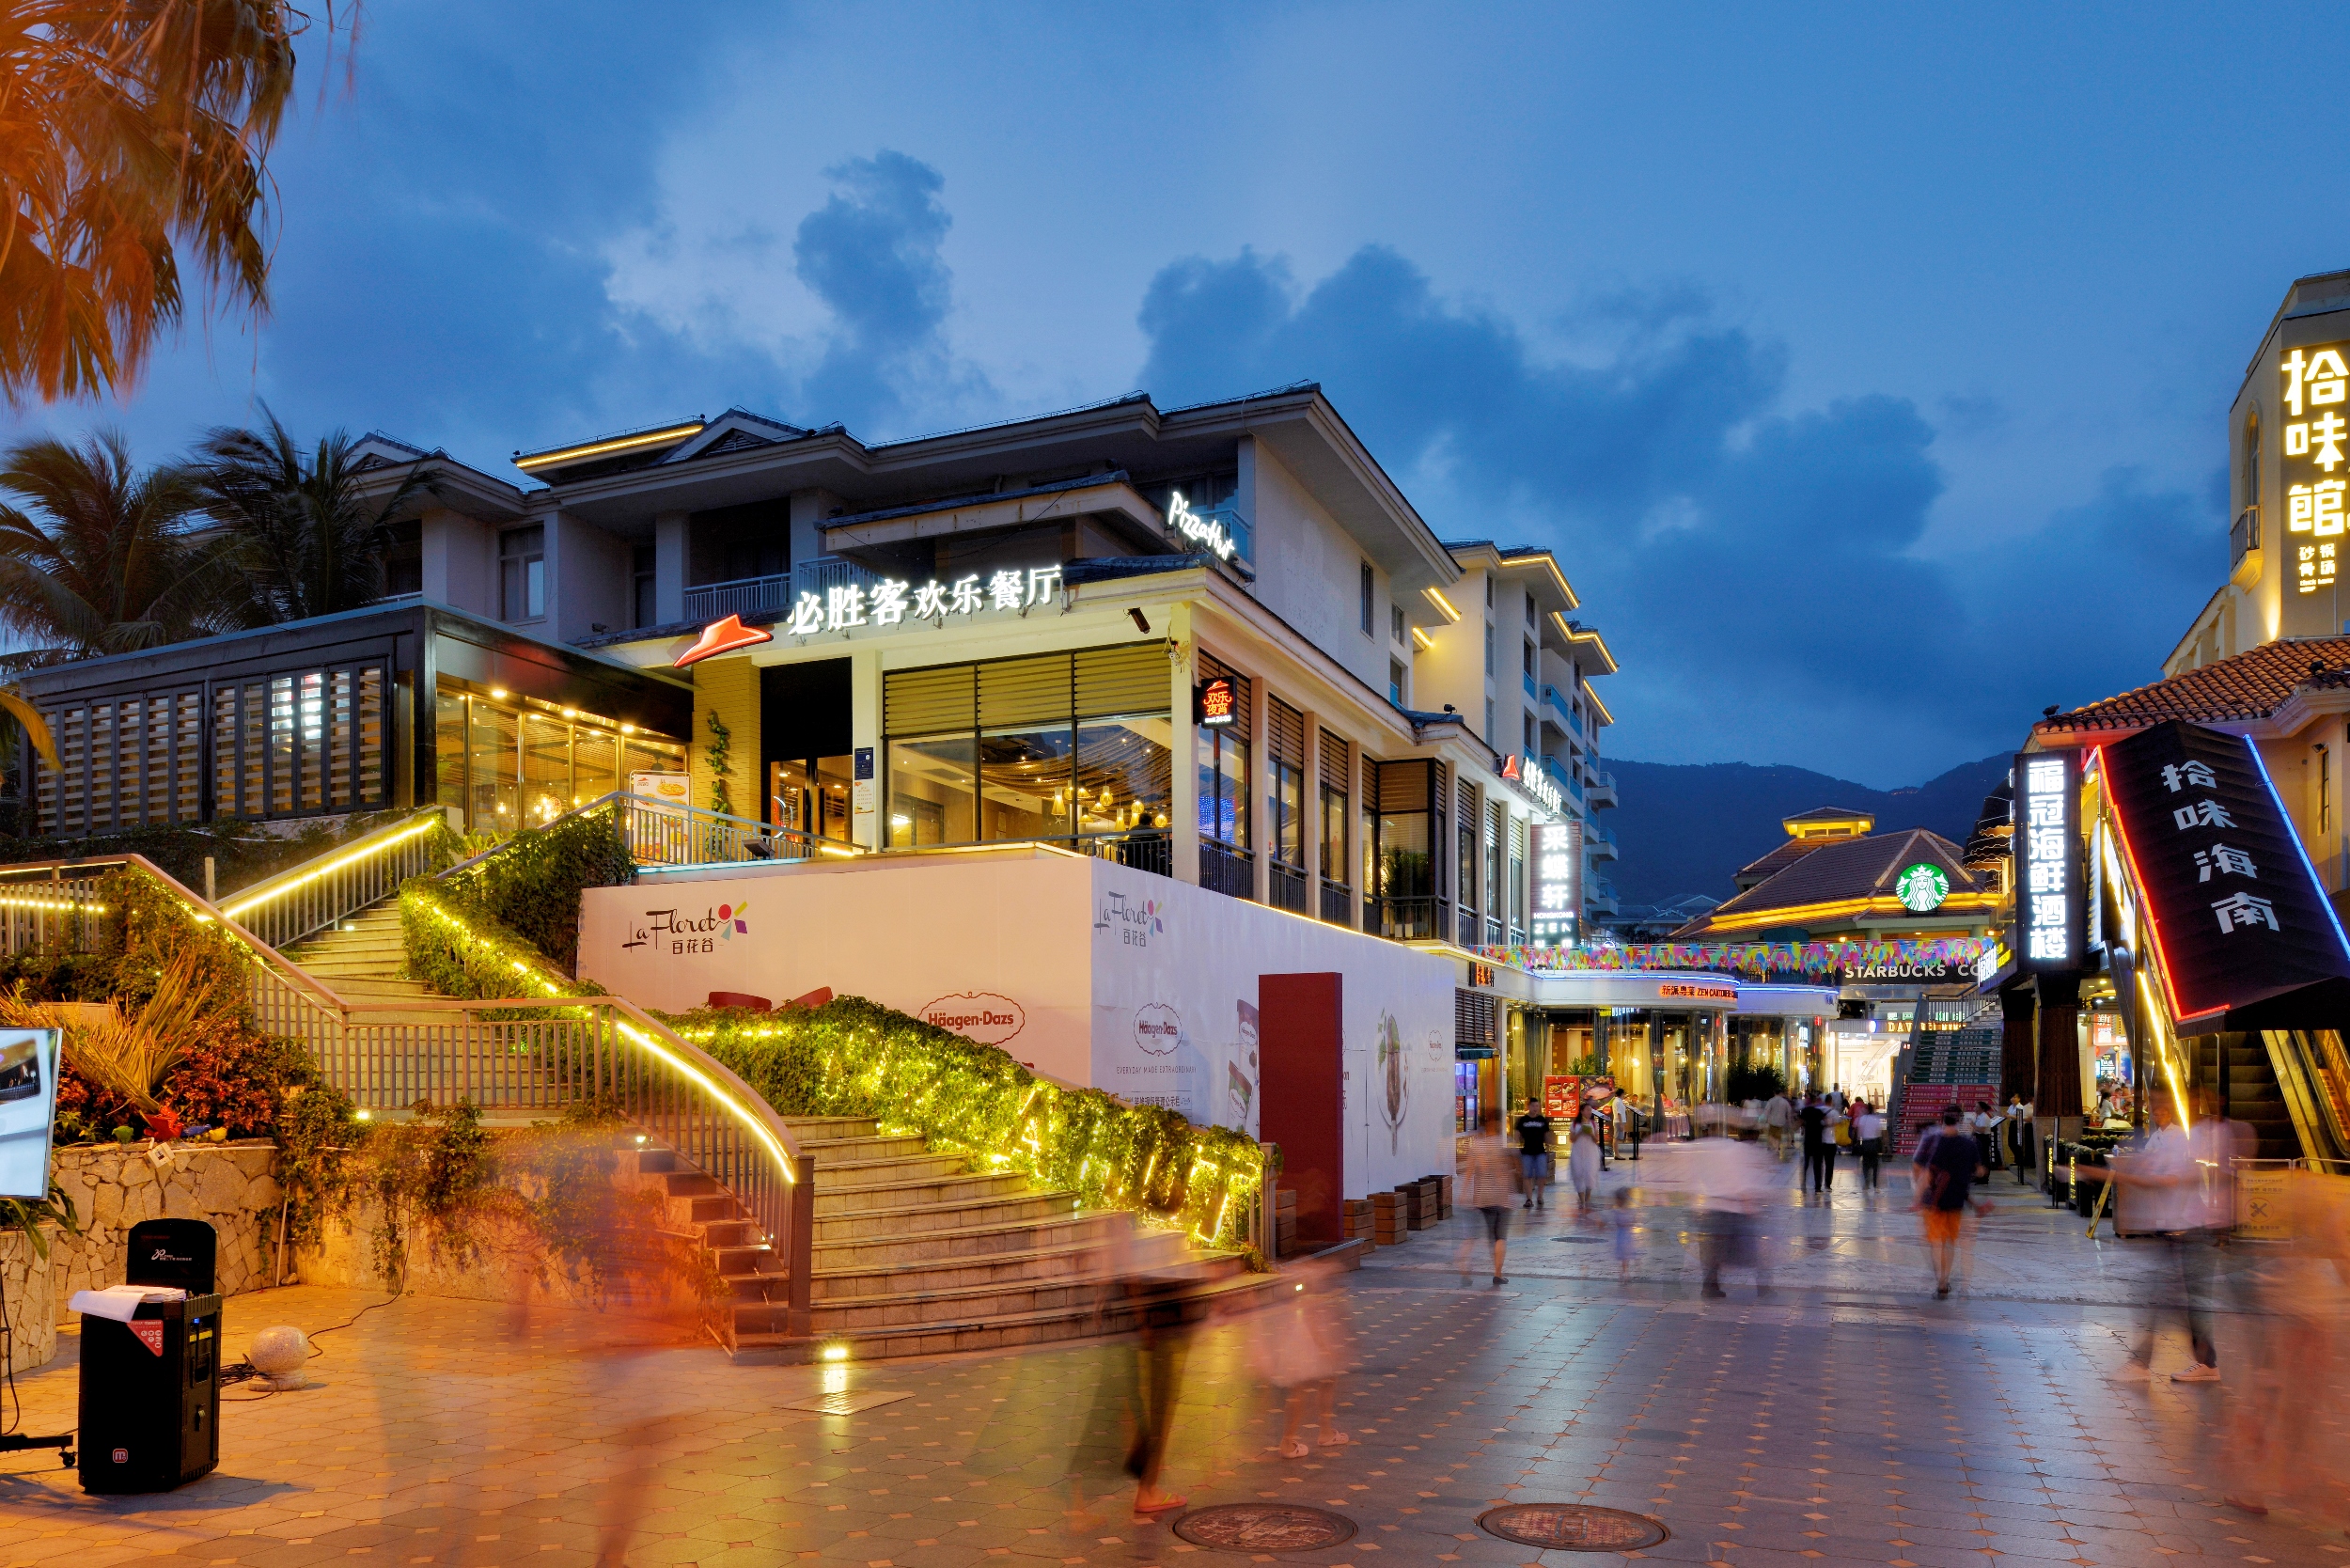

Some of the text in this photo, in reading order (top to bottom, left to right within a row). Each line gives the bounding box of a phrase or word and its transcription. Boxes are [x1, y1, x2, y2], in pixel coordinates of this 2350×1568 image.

[787, 564, 1062, 636] 必胜客欢乐餐厅
[1203, 690, 1232, 705] 欢乐
[2161, 760, 2280, 934] 拾味海南
[1542, 824, 1569, 909] 采蝶轩
[2029, 760, 2067, 959] 福冠海鲜酒楼
[1108, 890, 1148, 936] Floret
[1533, 911, 1574, 919] HONGKONG
[645, 907, 717, 950] Floret
[1122, 928, 1147, 948] 百花谷
[1534, 922, 1573, 935] ZEN
[671, 937, 713, 955] 百花谷
[1844, 964, 1947, 979] STARBUCKS
[928, 1011, 1014, 1031] Häagen-Dazs
[1138, 1020, 1178, 1039] Häagen-Dazs
[1116, 1066, 1142, 1074] EVERYDAY
[1143, 1065, 1158, 1074] MADE
